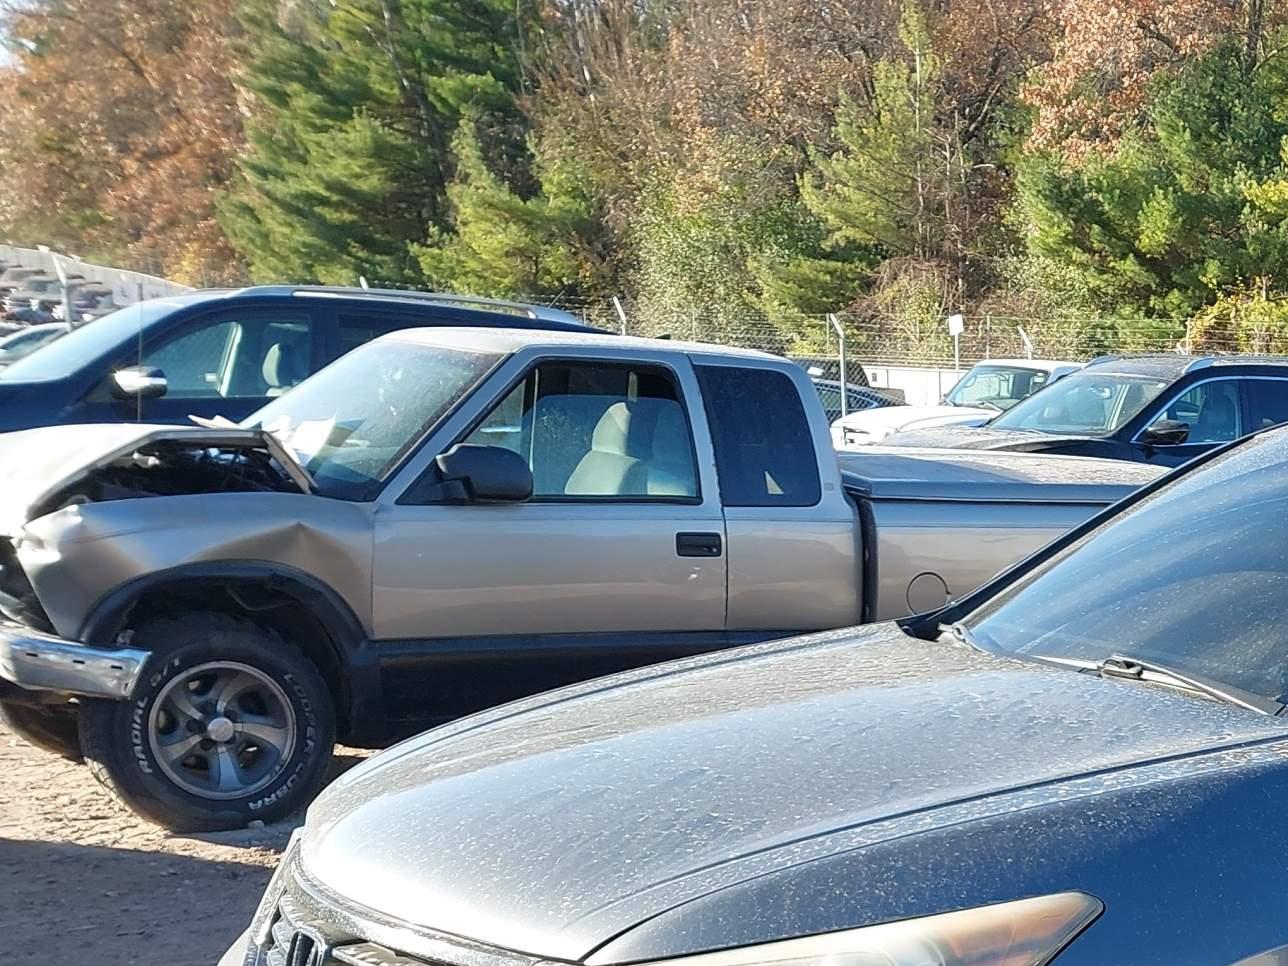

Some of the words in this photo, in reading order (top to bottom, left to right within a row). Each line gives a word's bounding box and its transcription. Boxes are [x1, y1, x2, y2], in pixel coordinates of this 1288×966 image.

[132, 697, 152, 773] RADIAL
[283, 674, 316, 753] COOPER
[248, 762, 303, 810] COBRA
